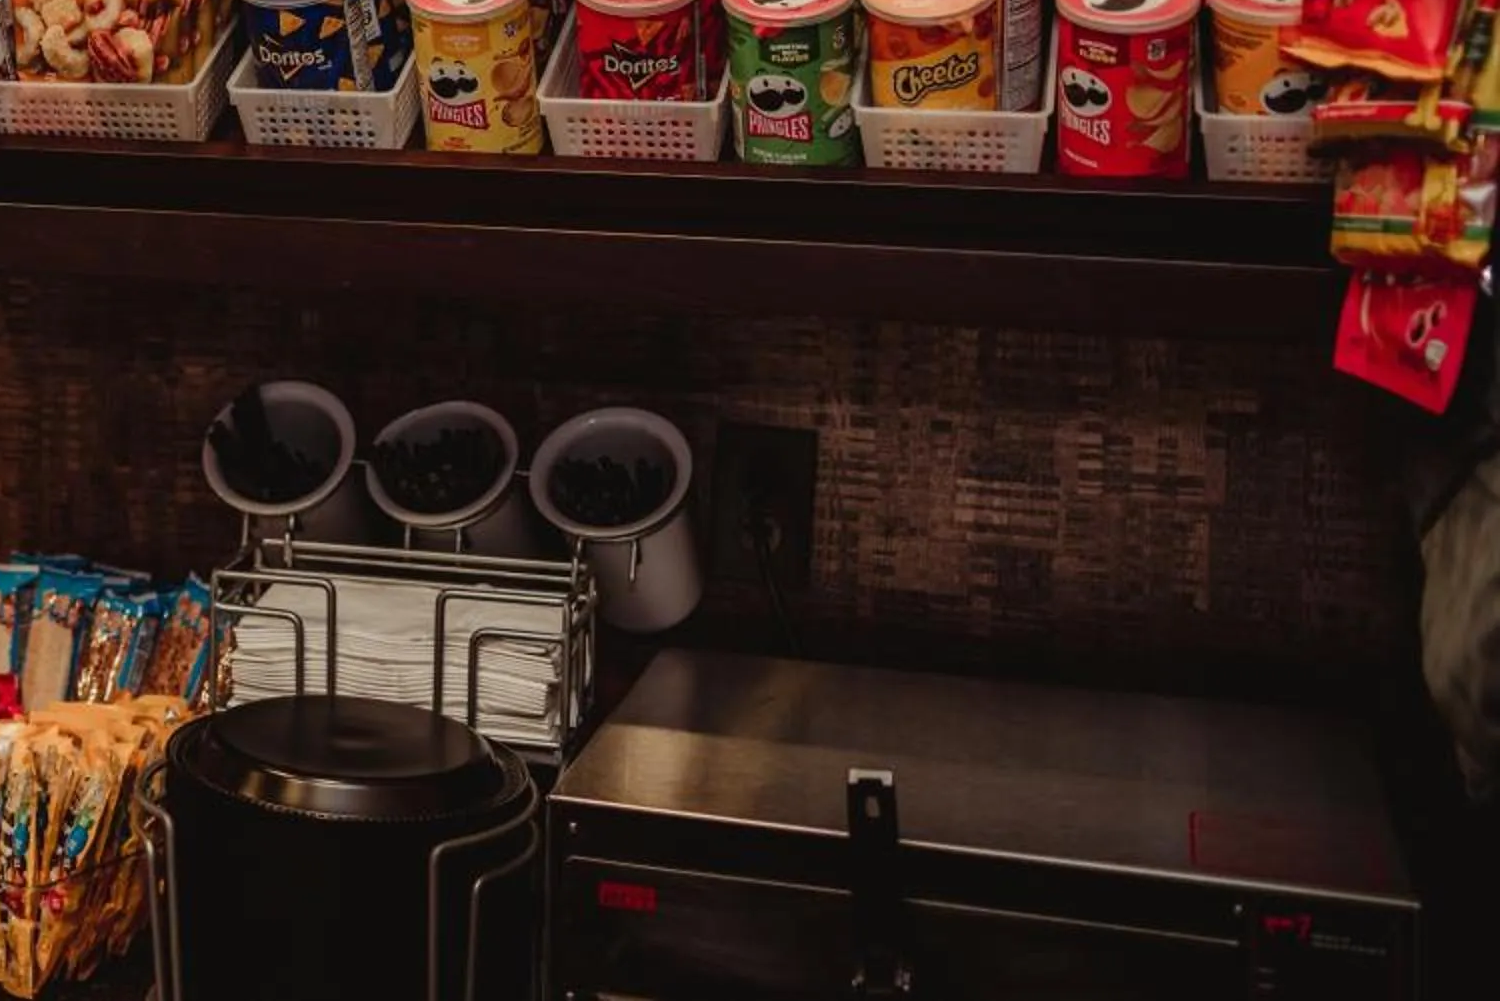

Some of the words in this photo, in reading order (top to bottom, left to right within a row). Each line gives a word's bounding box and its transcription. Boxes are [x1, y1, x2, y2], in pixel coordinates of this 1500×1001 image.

[258, 45, 326, 68] Doritos
[603, 54, 679, 76] Doritos
[895, 53, 979, 102] Cheetos
[430, 98, 486, 128] PRINGLES
[748, 109, 810, 140] PRINGLES
